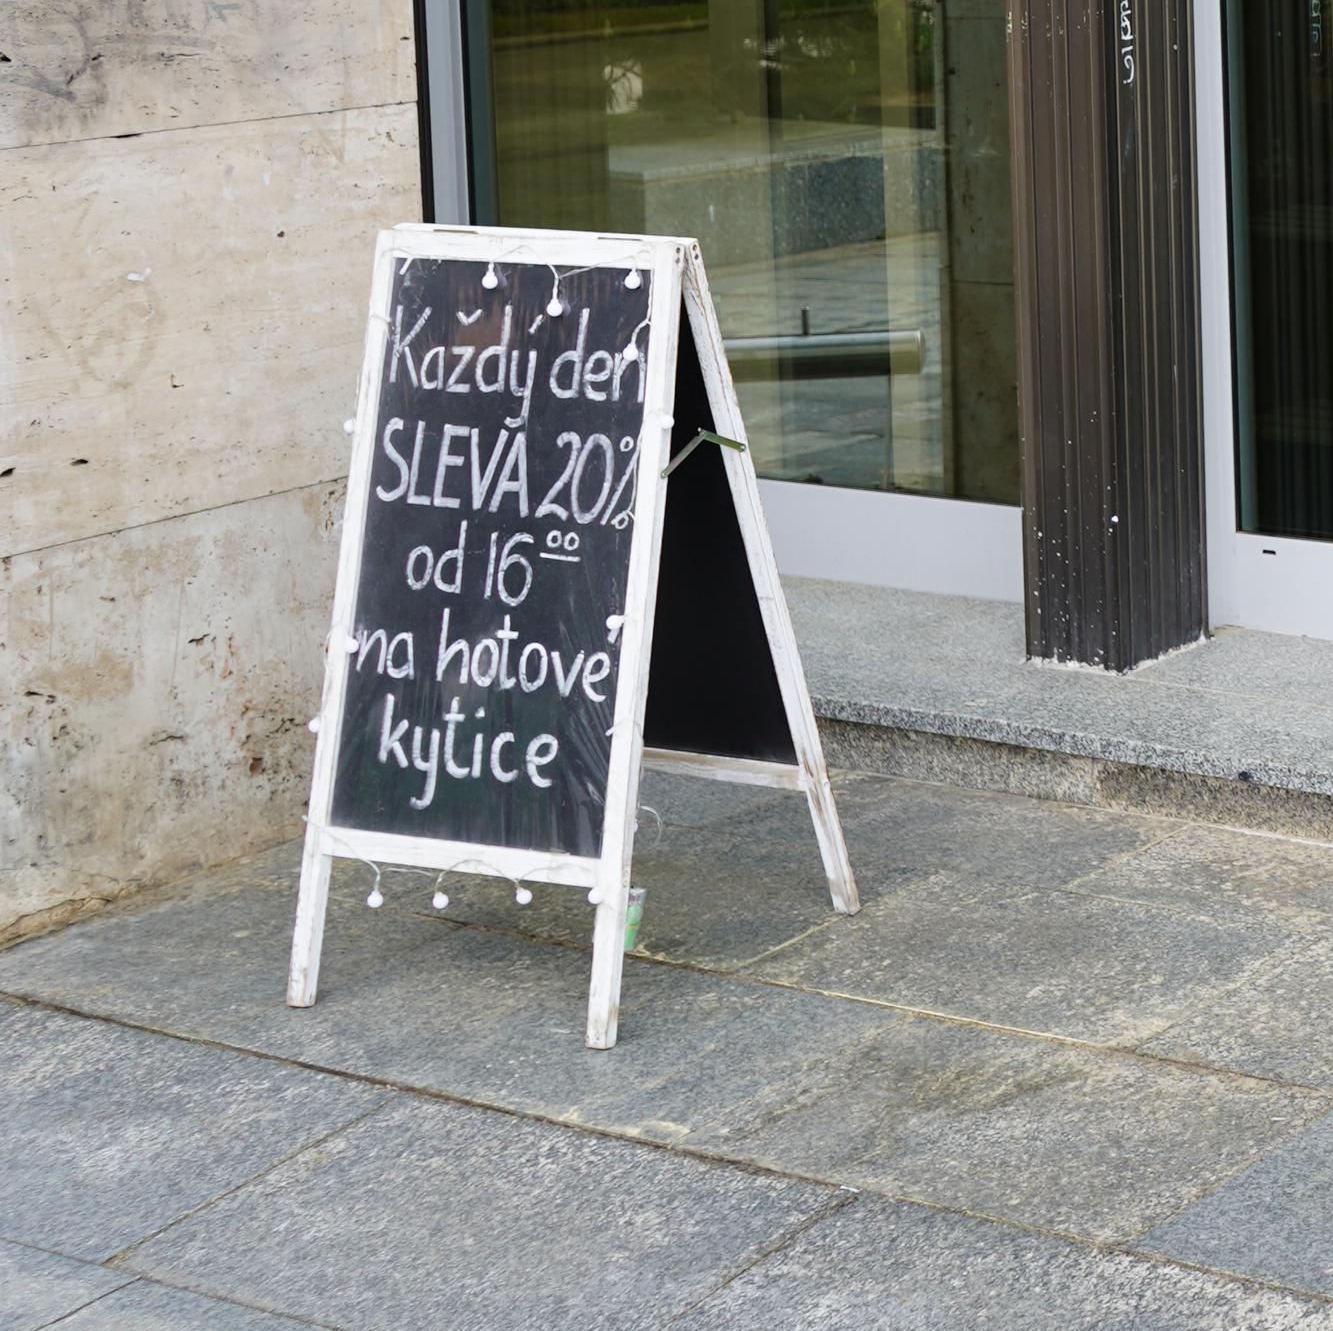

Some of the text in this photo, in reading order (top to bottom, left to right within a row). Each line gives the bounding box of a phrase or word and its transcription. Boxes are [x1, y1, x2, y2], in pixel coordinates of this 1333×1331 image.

[390, 305, 646, 427] Každý den
[535, 430, 640, 531] 20%
[405, 520, 467, 595] od
[355, 627, 415, 682] na
[378, 693, 559, 811] kytice
